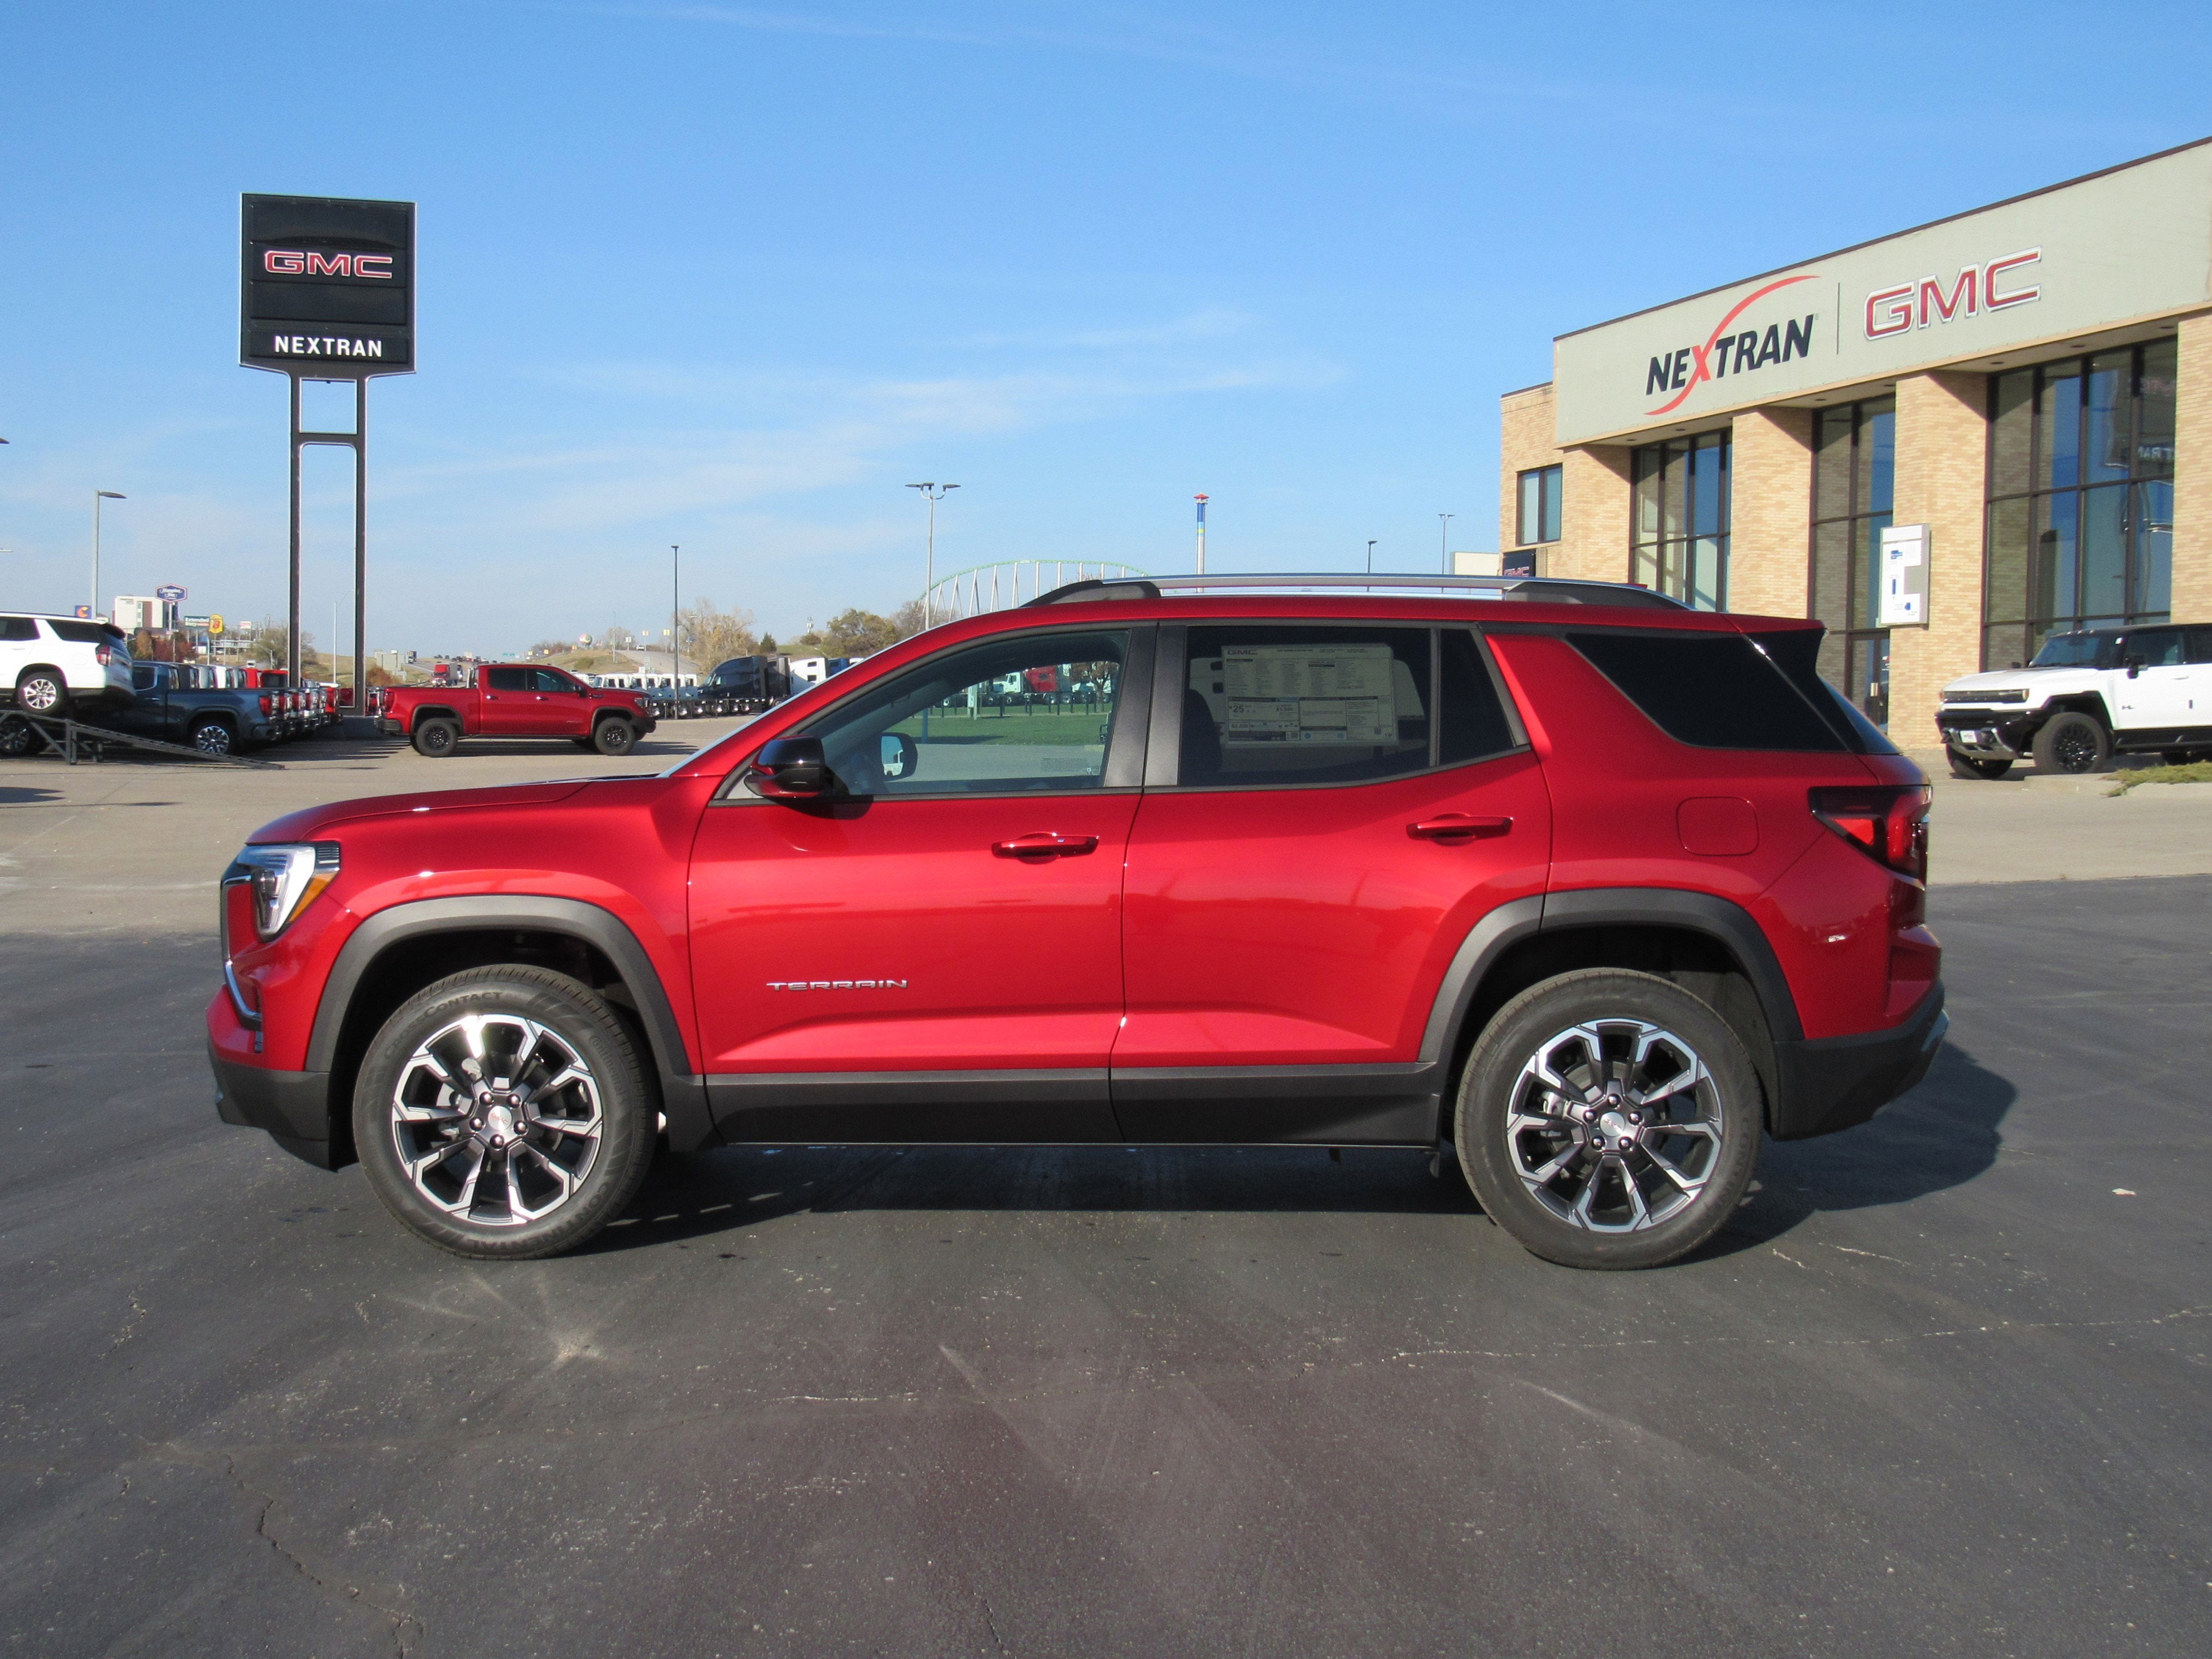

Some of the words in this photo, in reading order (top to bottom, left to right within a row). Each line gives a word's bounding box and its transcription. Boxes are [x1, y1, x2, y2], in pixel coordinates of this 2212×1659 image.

[264, 250, 393, 279] GMC
[1863, 246, 2043, 341] GMC
[274, 335, 382, 357] NEXTRAN
[1645, 313, 1815, 398] NEXTRAN
[1503, 566, 1530, 577] GMC
[1233, 705, 1244, 713] 25
[766, 980, 907, 992] TERRAIN
